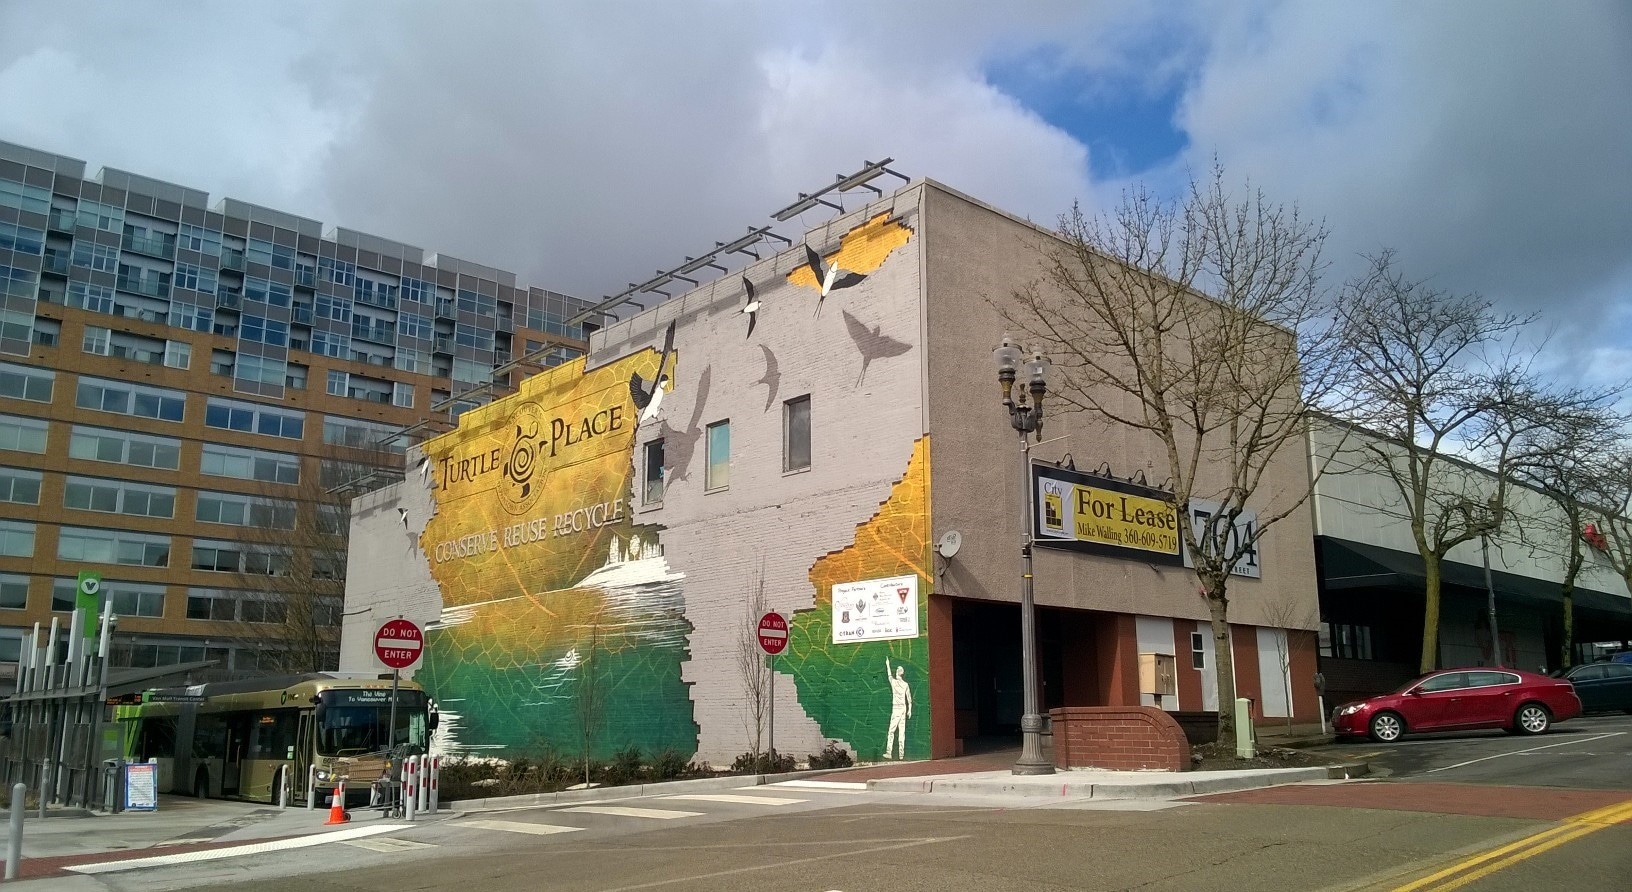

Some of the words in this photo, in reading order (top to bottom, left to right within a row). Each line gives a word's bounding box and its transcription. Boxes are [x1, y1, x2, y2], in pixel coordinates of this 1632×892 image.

[439, 448, 500, 492] TURTLE
[550, 405, 622, 458] PLACE
[1044, 481, 1062, 496] City
[1077, 488, 1114, 519] For
[1120, 497, 1175, 530] Lease
[435, 530, 497, 564] CONSERVE
[503, 518, 547, 548] REUSE
[553, 499, 625, 538] RECYCLE
[1077, 522, 1096, 536] Mike
[1096, 525, 1122, 545] Walling
[1124, 529, 1177, 551] 360-609-5719
[1194, 509, 1258, 567] 704
[383, 628, 396, 637] DO
[400, 629, 418, 638] NOT
[762, 619, 771, 627] DO
[773, 621, 785, 629] NOT
[763, 639, 782, 647] ENTER
[384, 650, 412, 660] ENTER
